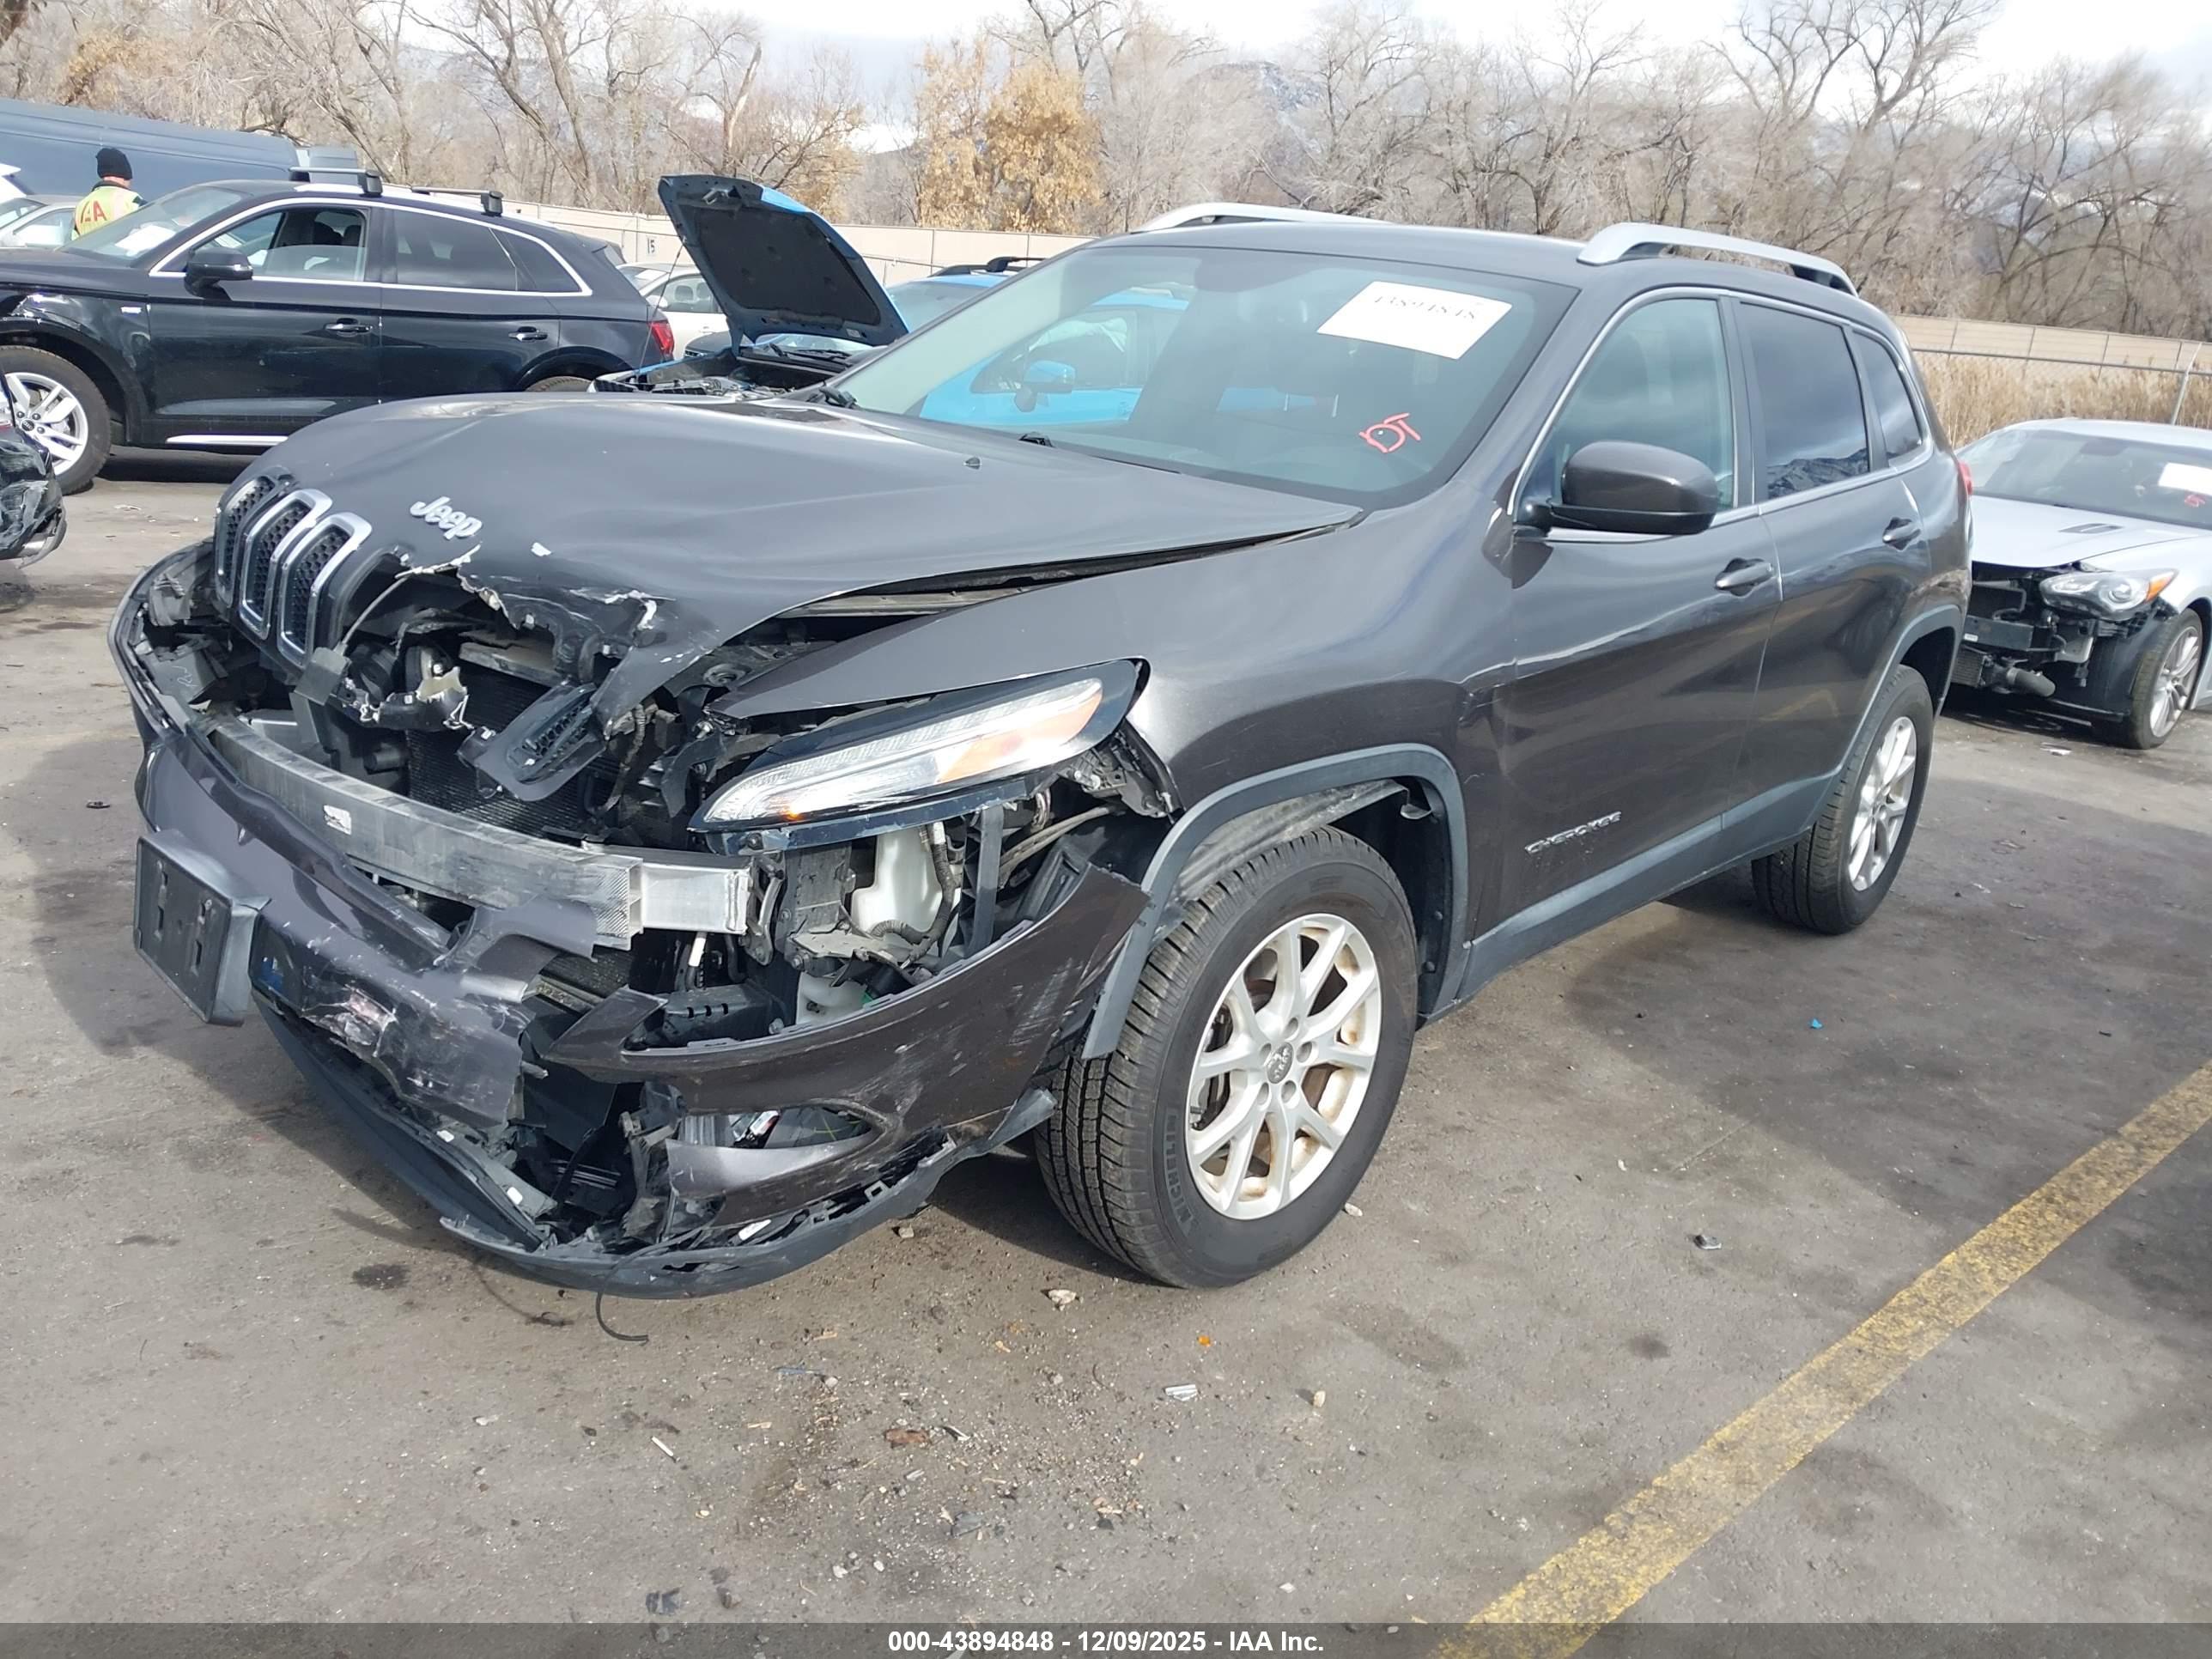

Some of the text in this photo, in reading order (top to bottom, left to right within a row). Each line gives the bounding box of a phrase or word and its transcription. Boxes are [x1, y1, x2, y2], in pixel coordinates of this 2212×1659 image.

[647, 237, 655, 254] 15
[410, 495, 483, 539] Jeep
[1165, 1114, 1192, 1224] MICHELIN
